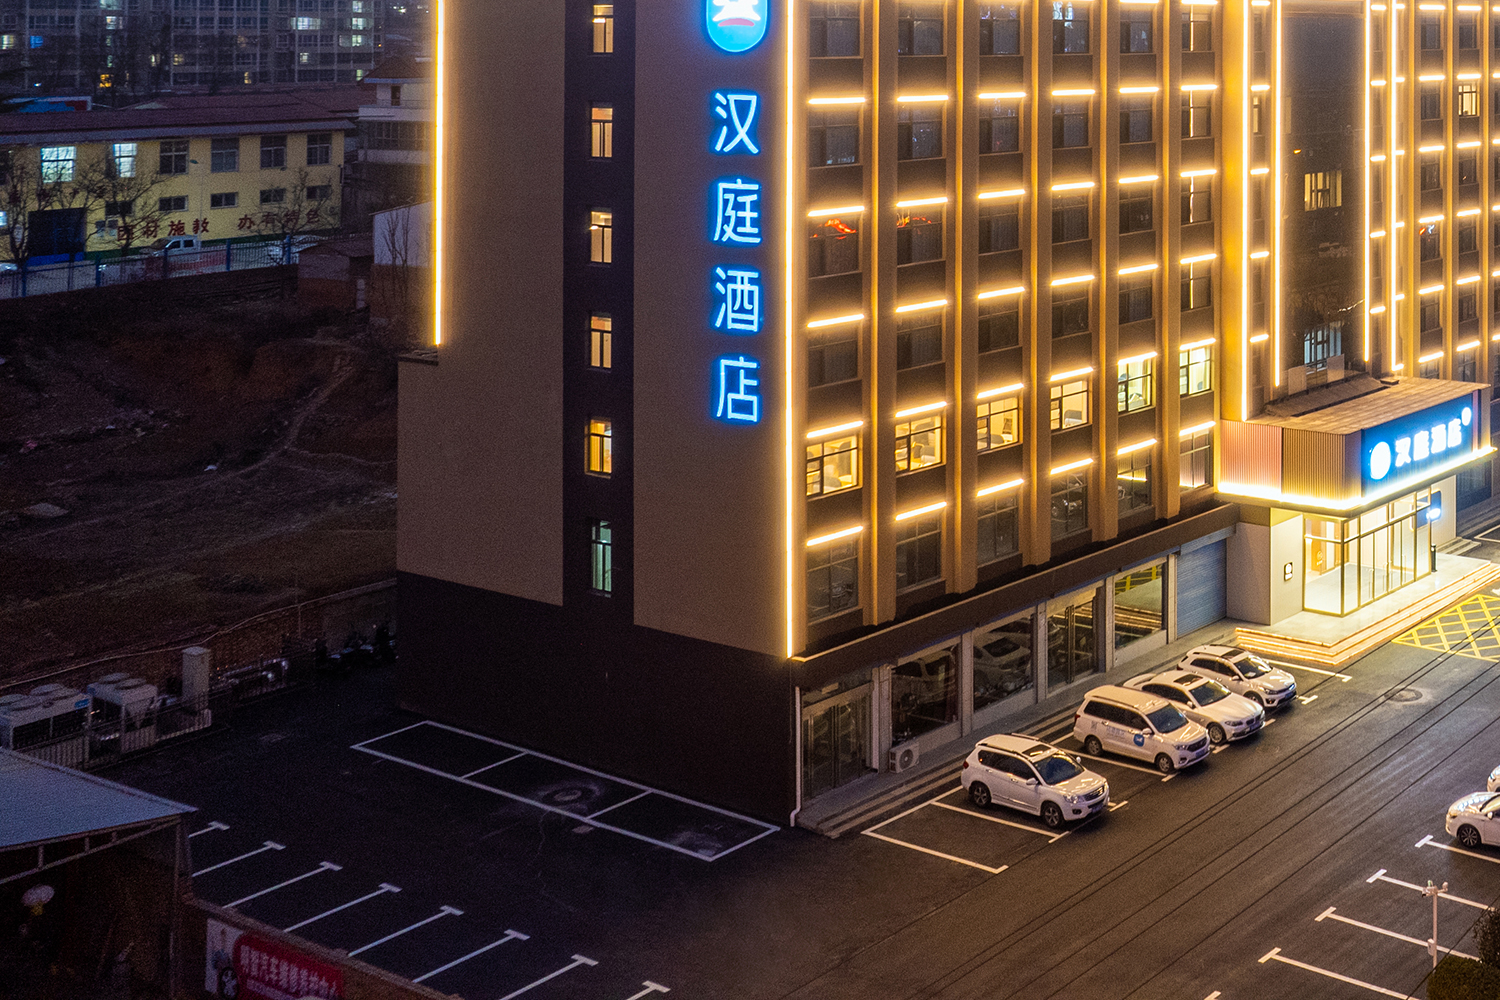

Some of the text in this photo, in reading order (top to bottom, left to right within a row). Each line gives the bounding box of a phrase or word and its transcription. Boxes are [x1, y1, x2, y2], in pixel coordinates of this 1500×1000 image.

[116, 209, 321, 242] 因材施教 办有特色
[713, 91, 760, 423] 汉庭酒店
